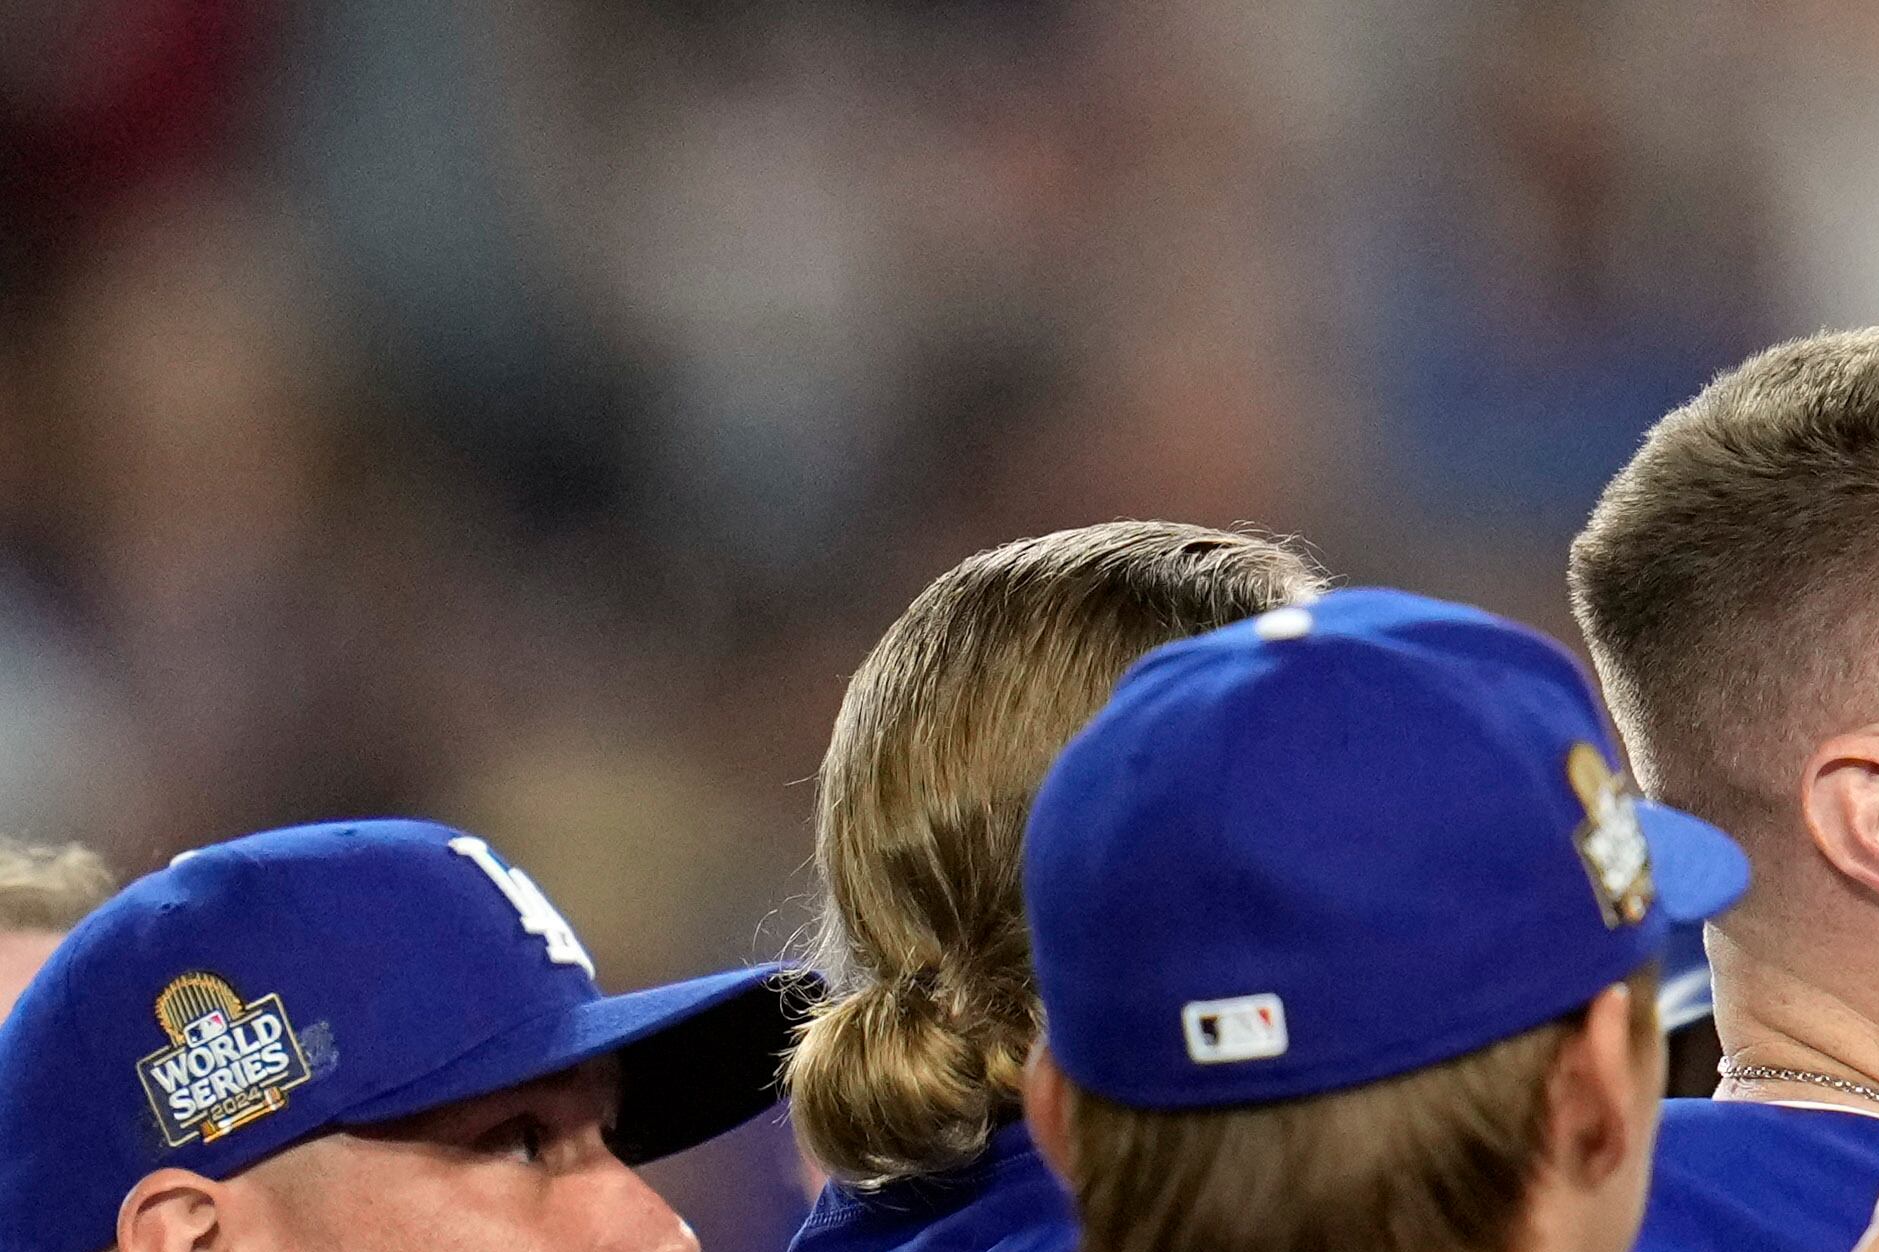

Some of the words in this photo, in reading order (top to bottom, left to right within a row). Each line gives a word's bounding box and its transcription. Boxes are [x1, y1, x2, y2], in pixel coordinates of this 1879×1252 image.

[151, 1014, 282, 1093] WORLD
[169, 1042, 289, 1121] SERIES
[210, 1086, 264, 1121] 2024
